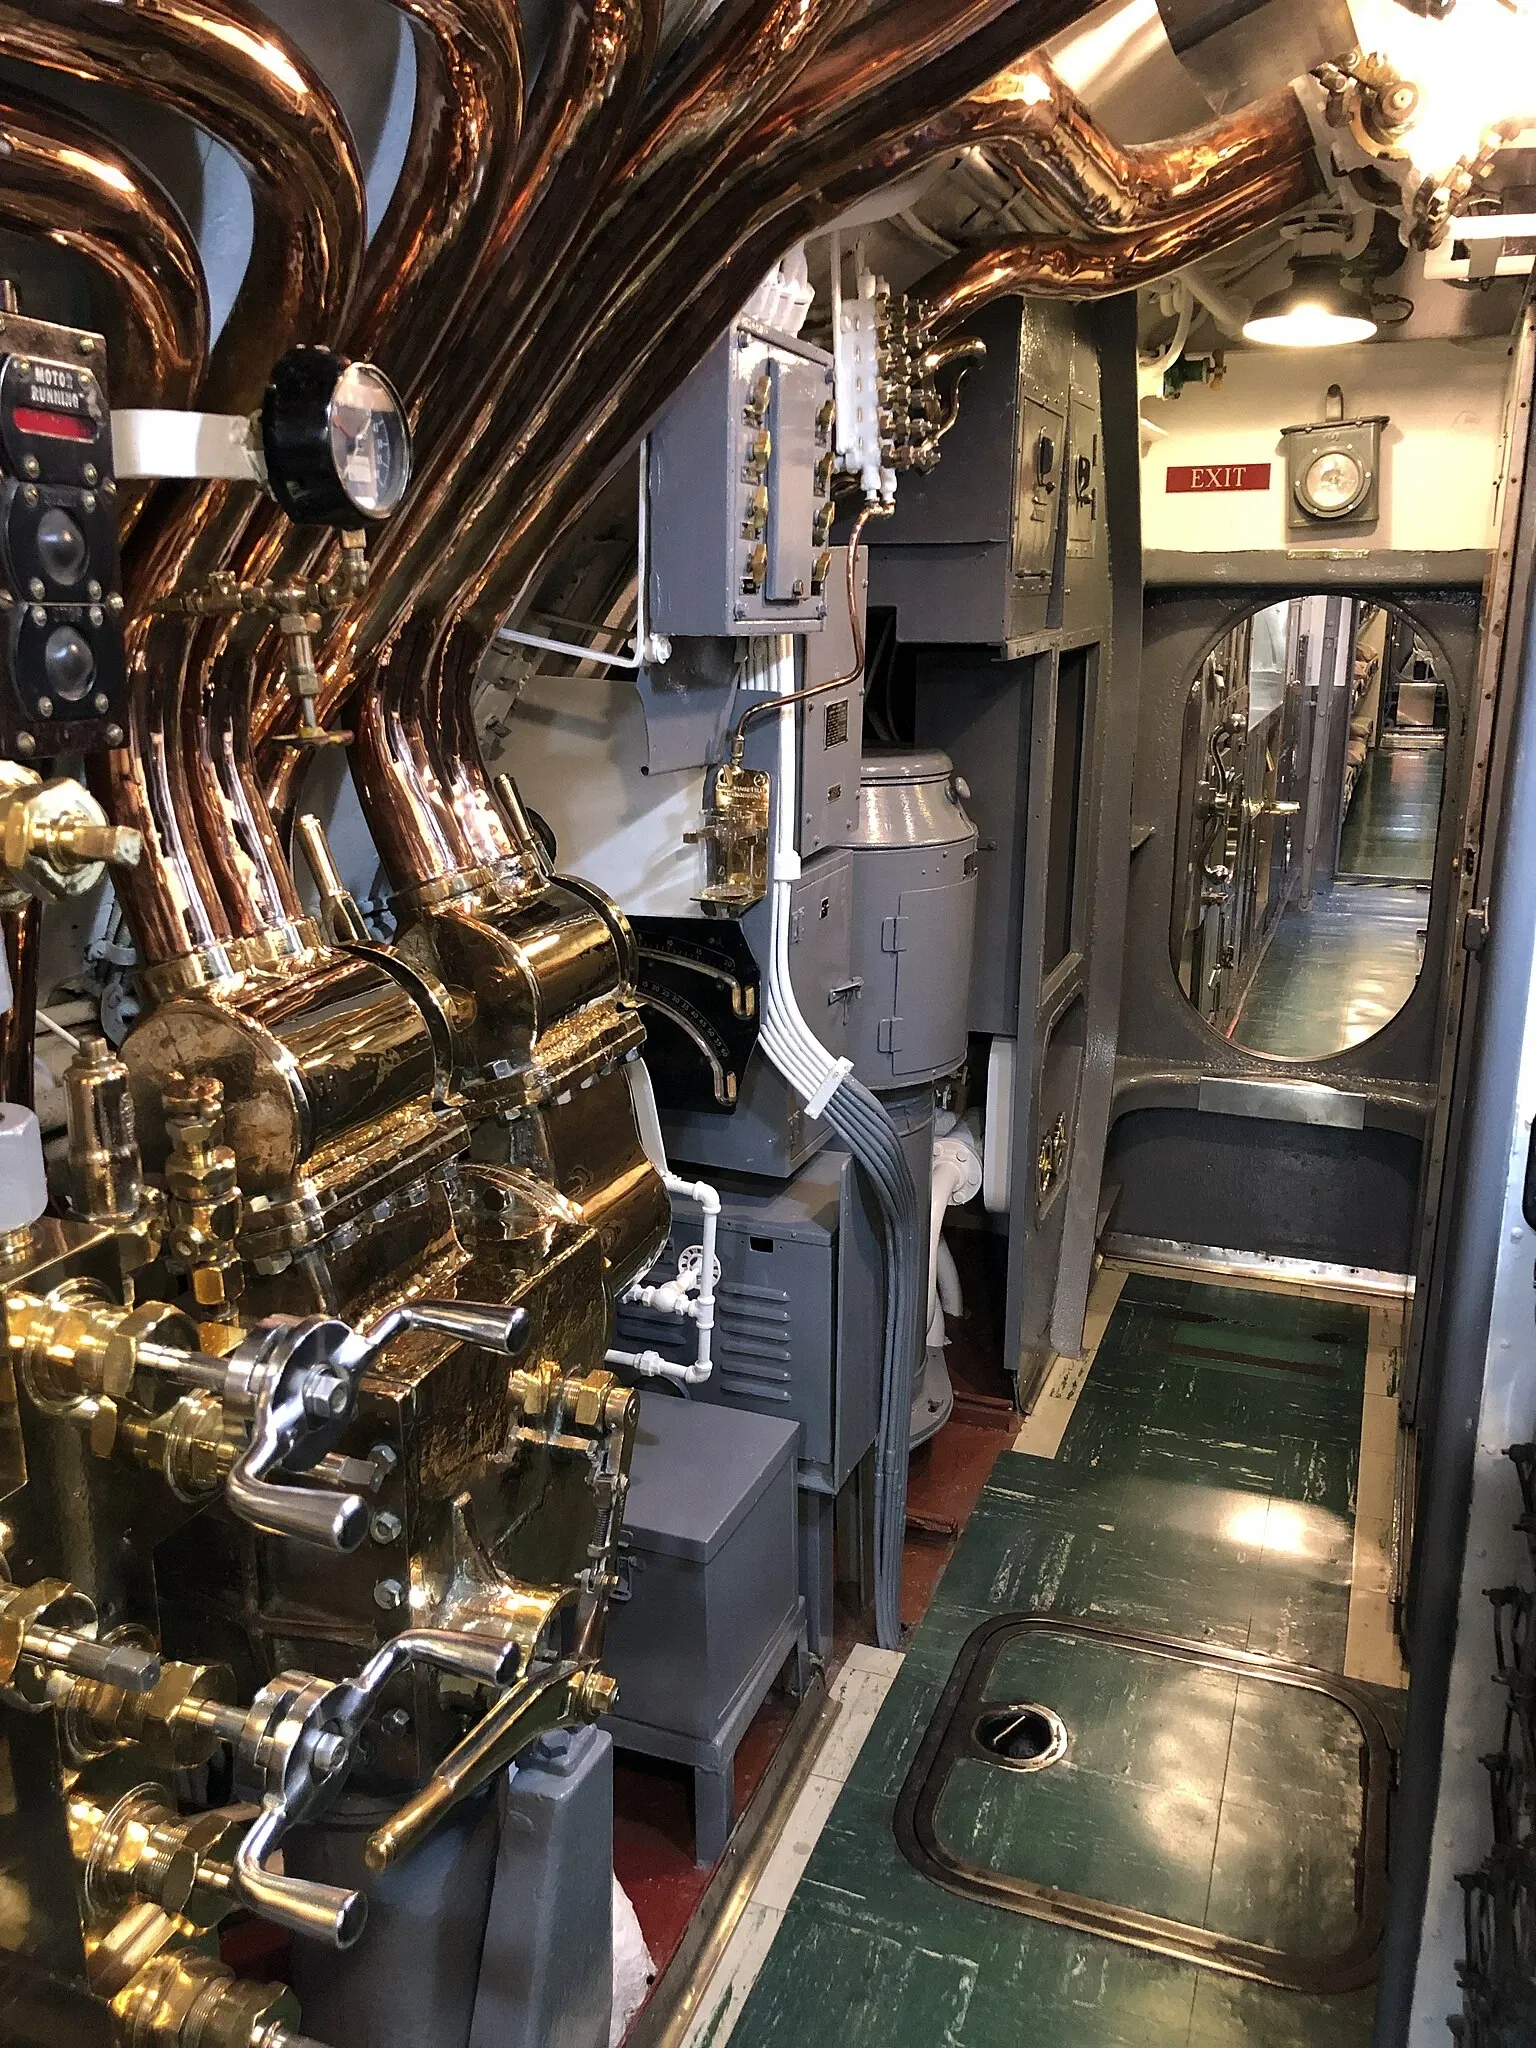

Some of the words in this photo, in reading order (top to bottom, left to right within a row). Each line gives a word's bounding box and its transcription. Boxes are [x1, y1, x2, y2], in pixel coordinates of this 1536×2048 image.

[34, 366, 73, 389] MOTOR
[31, 384, 79, 408] RUNNING
[1190, 467, 1247, 488] EXIT
[695, 947, 702, 956] 15
[723, 960, 733, 968] 20
[651, 984, 660, 992] 20
[661, 989, 670, 998] 25
[671, 995, 680, 1004] 30
[681, 1002, 690, 1011] 35
[690, 1010, 699, 1019] 40
[699, 1019, 707, 1028] 45
[706, 1027, 715, 1037] 50
[720, 1048, 729, 1058] 60
